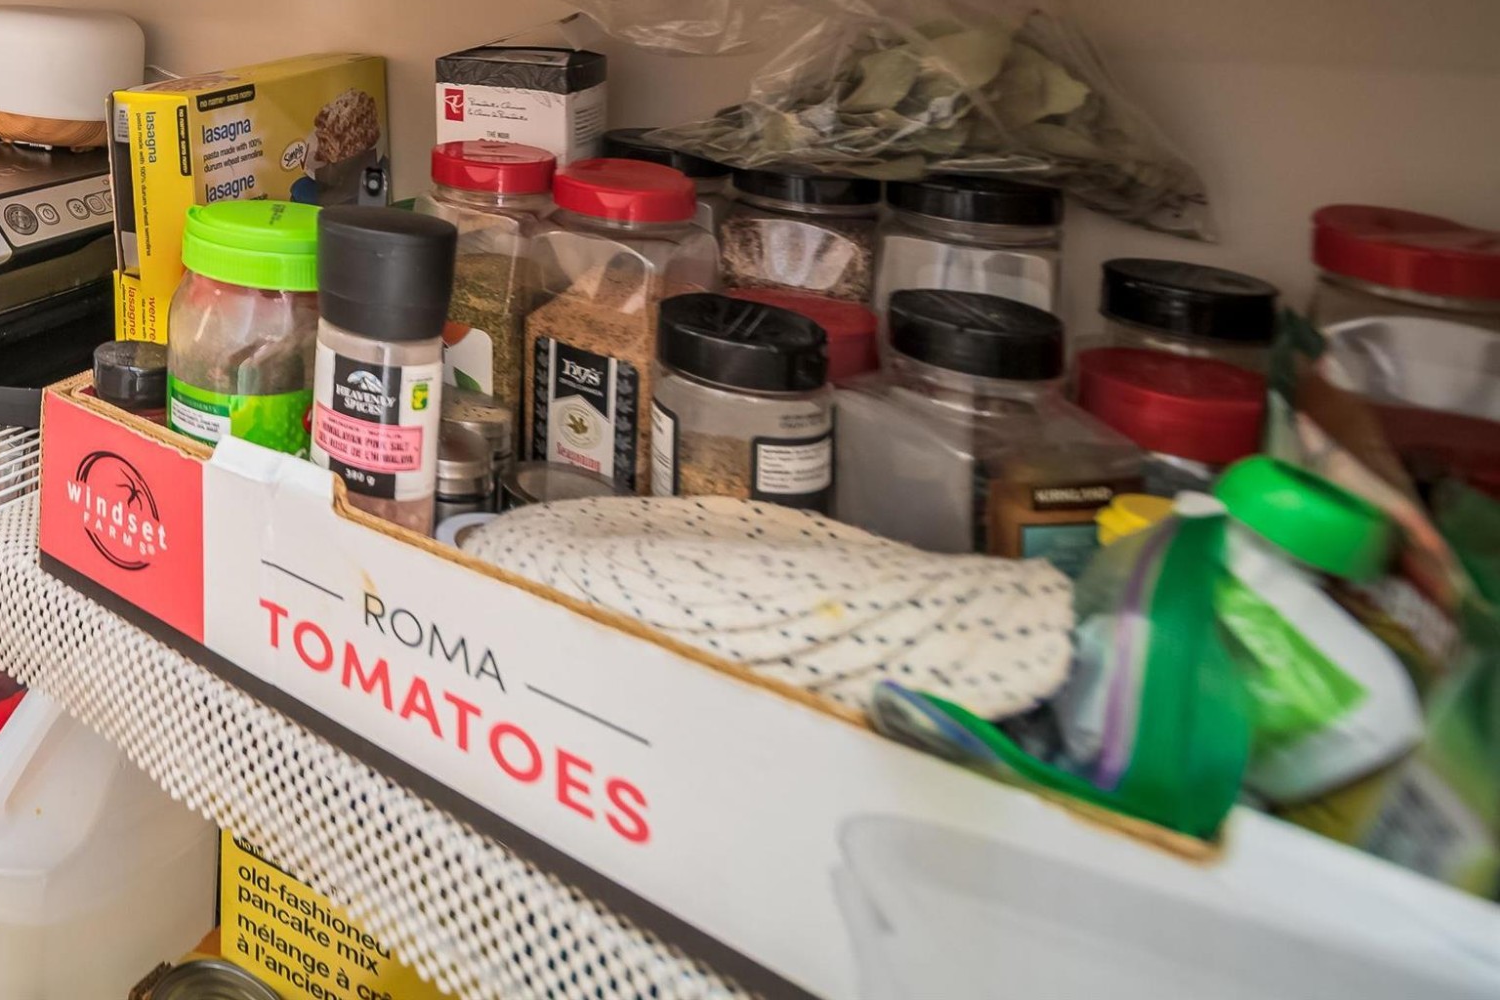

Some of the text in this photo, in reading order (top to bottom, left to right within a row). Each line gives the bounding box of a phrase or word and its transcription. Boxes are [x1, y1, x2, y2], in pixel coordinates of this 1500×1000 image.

[146, 111, 156, 163] lasagna
[202, 118, 251, 145] lasagna
[202, 137, 262, 163] pasta made with 100%
[203, 149, 263, 173] durum wheat semolina
[205, 174, 255, 203] lasagne
[128, 287, 137, 336] lasagne
[336, 384, 396, 408] HEAVENLY
[344, 397, 383, 415] SPICES
[67, 481, 167, 550] windset
[363, 591, 507, 694] ROMA
[259, 597, 651, 846] TOMATOES
[237, 913, 330, 978] mélange
[336, 967, 350, 991] à
[238, 884, 379, 976] pancake mix
[237, 934, 341, 1000] à l'ancien
